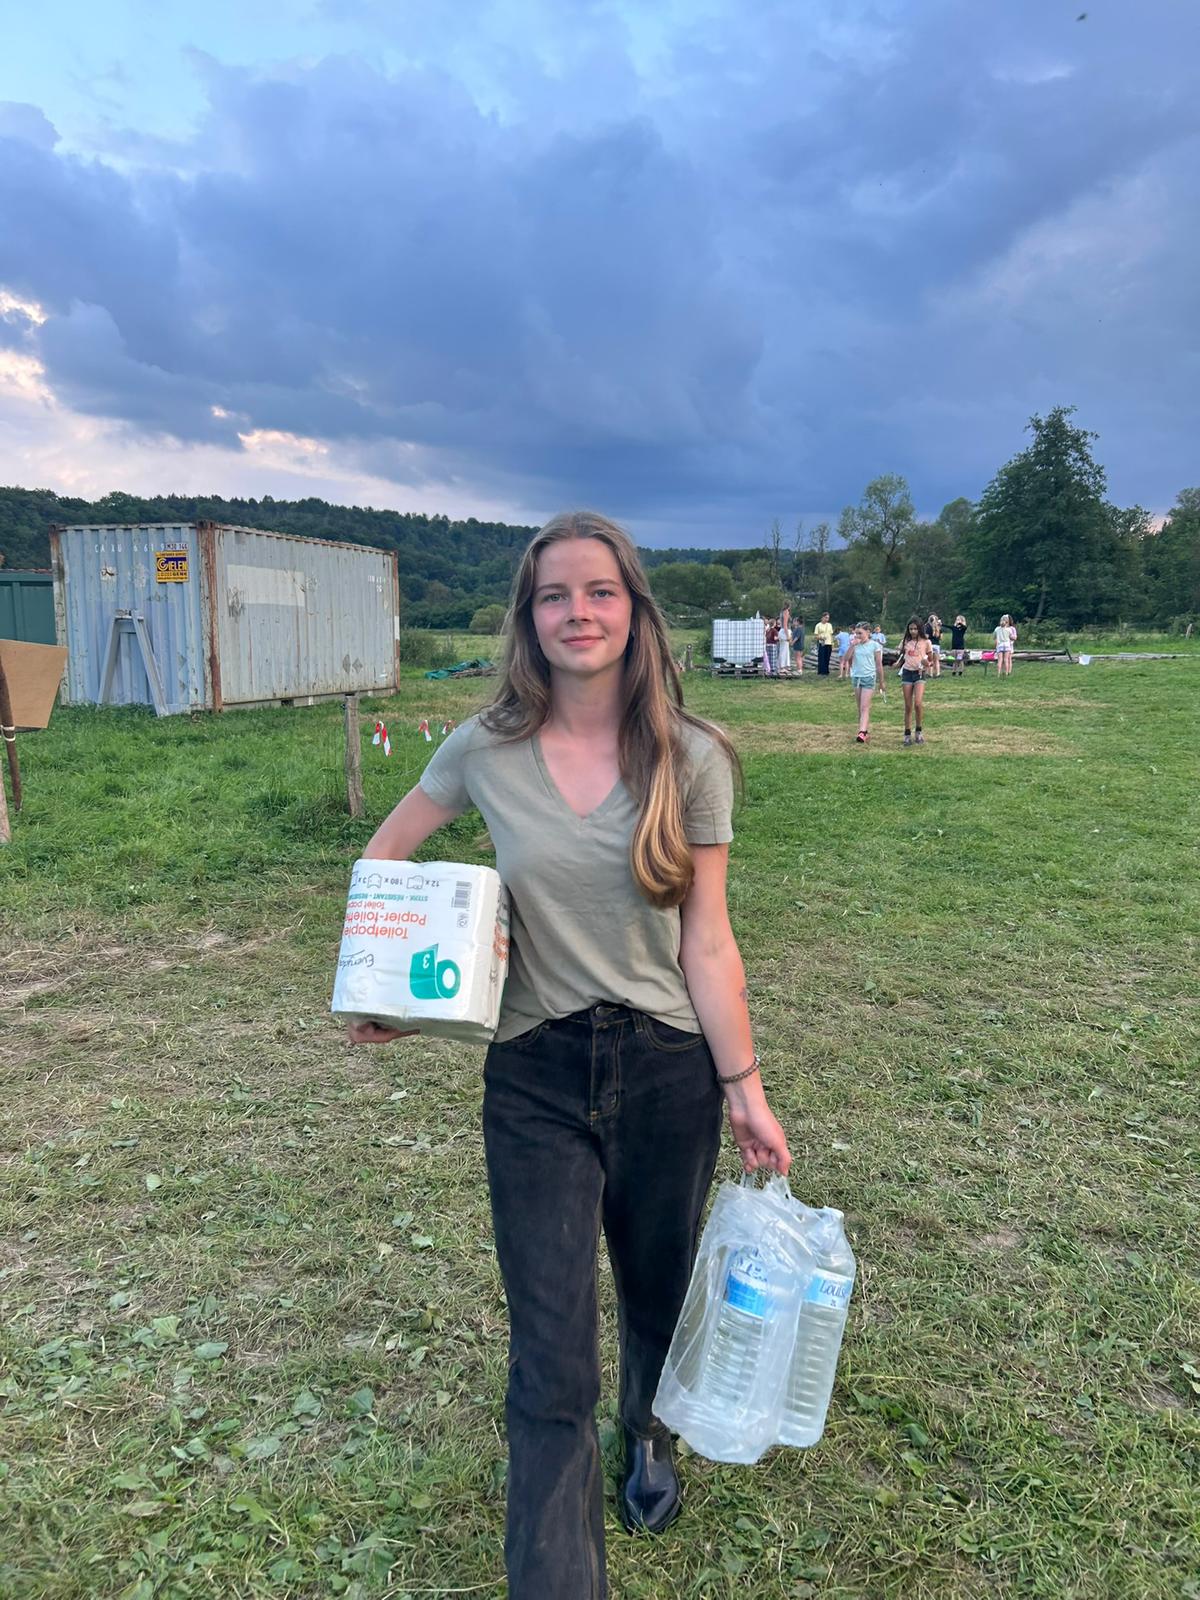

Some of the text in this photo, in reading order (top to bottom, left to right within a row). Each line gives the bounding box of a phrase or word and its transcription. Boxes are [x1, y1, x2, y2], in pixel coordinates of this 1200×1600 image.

[157, 557, 188, 571] GIELEN
[363, 901, 385, 910] Toilet
[422, 953, 431, 969] 3
